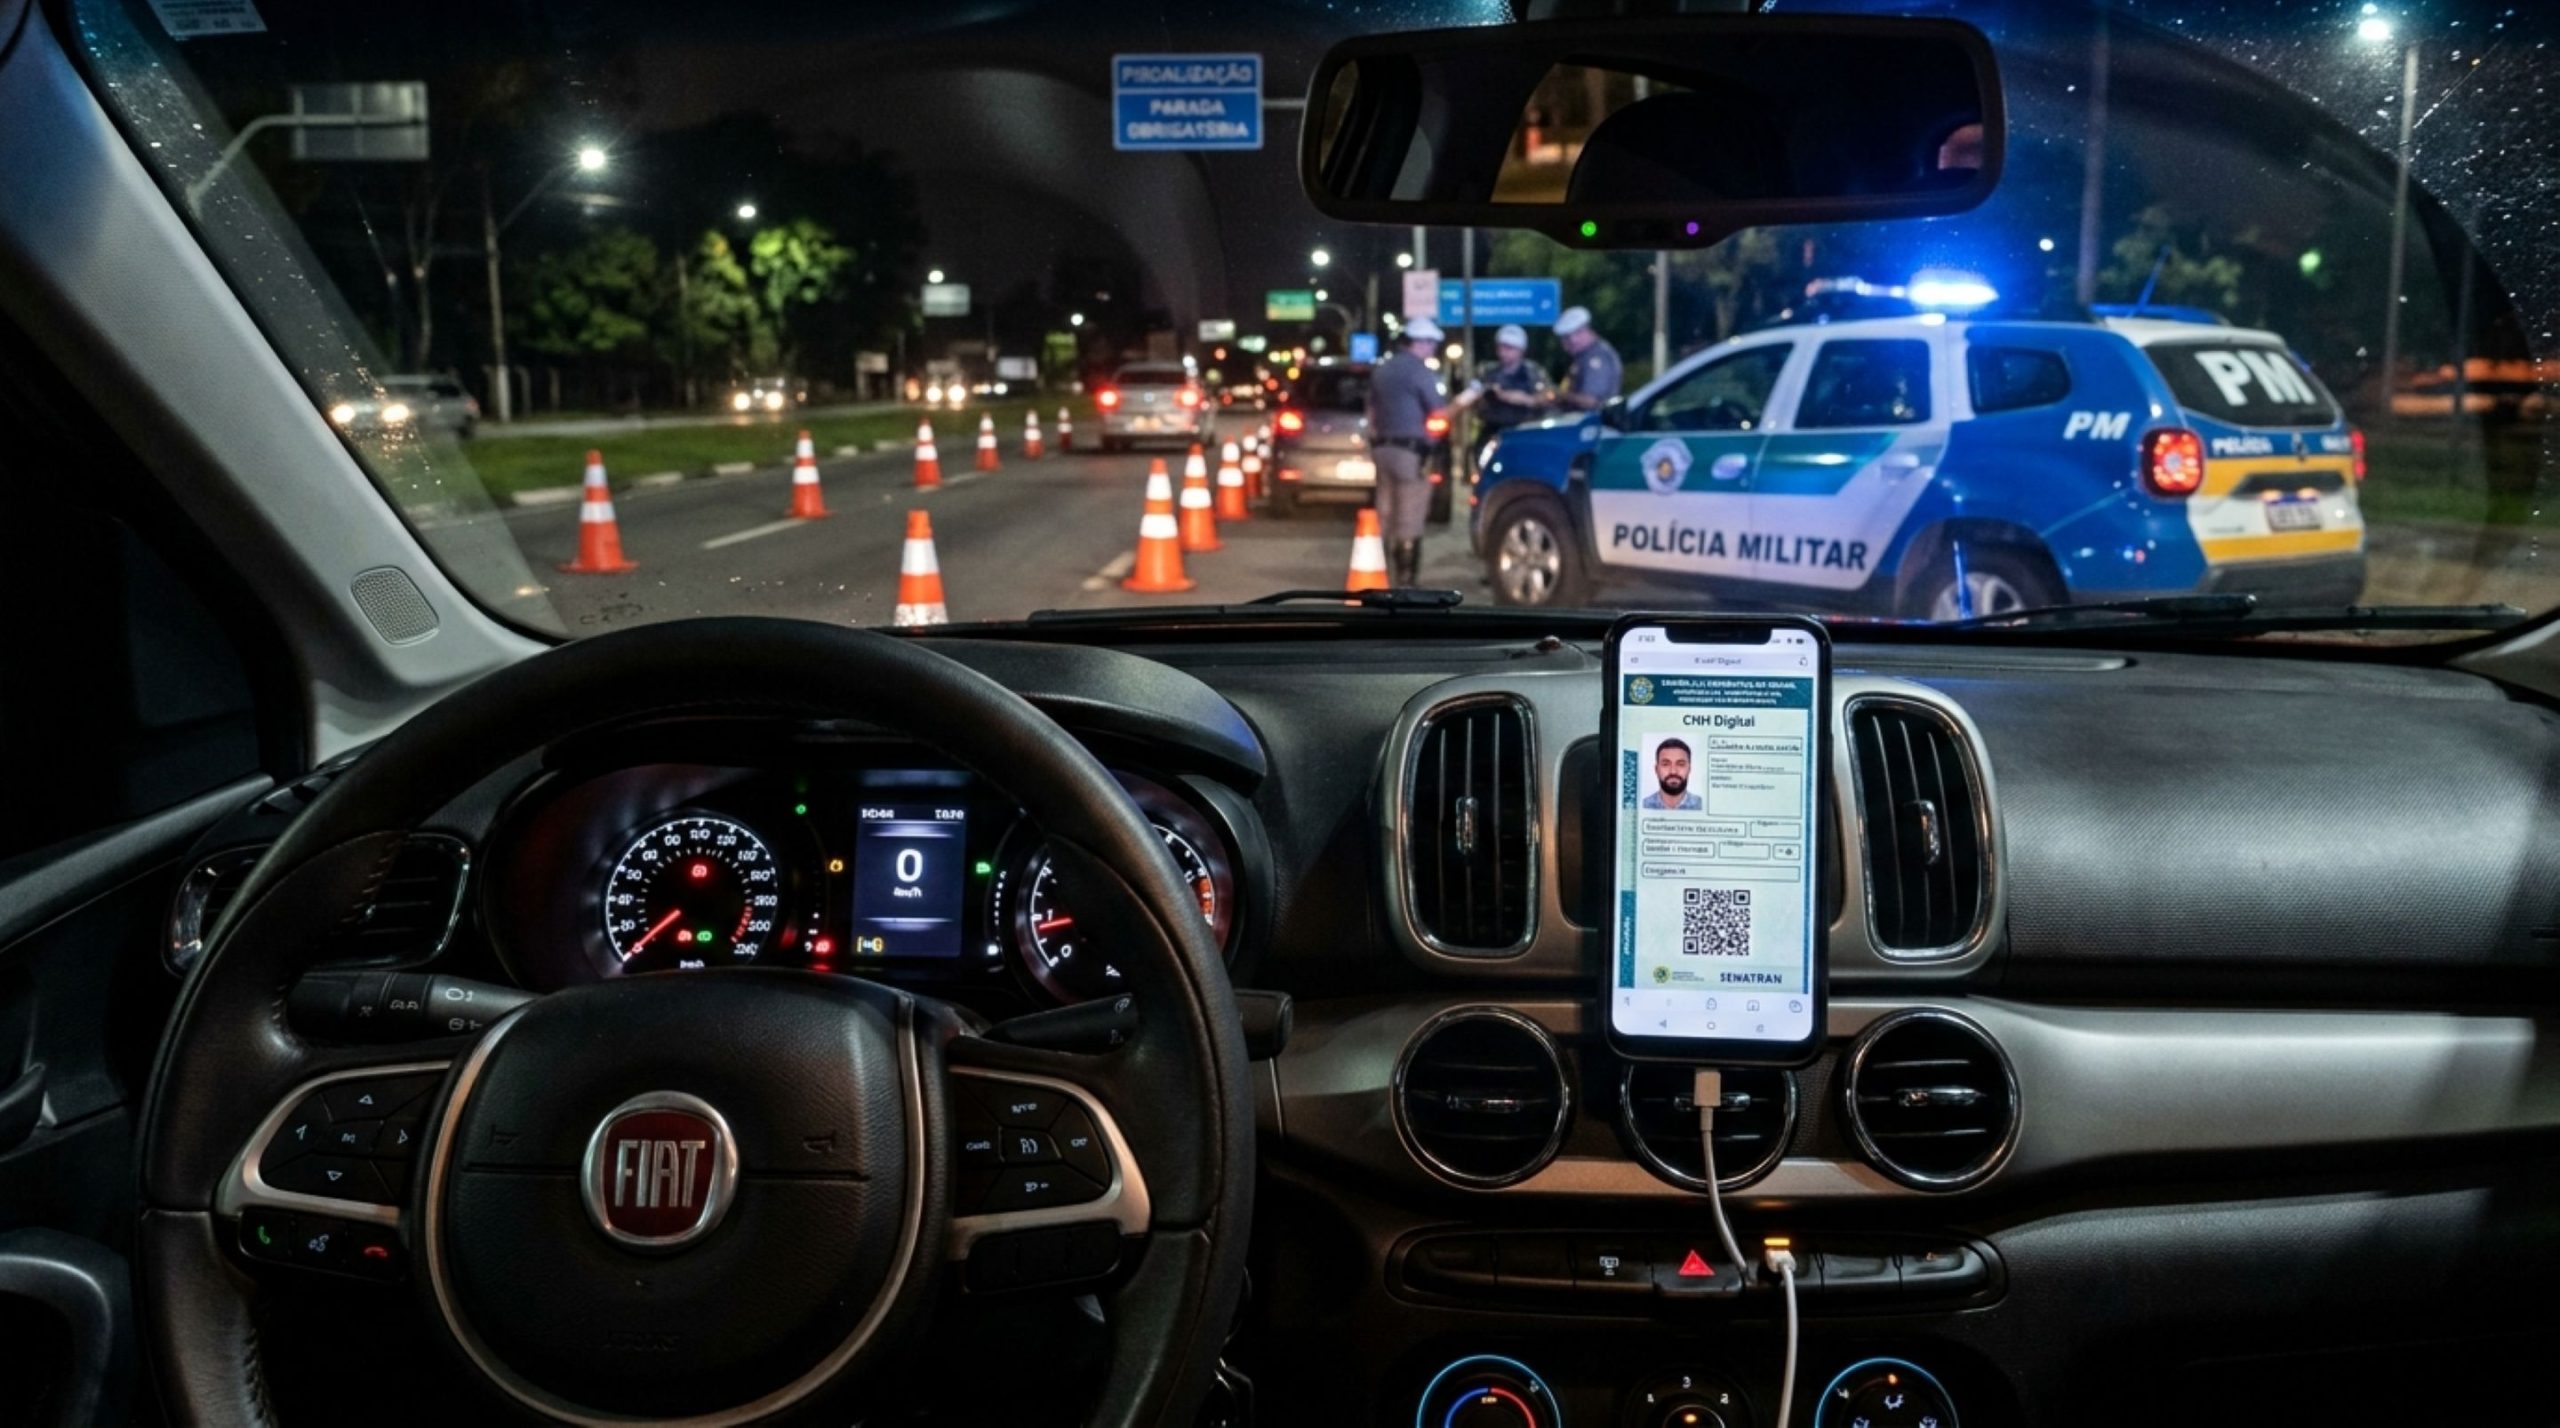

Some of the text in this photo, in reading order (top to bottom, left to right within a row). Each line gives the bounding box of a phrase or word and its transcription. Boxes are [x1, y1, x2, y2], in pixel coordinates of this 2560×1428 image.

[1150, 98, 1226, 116] PARADA
[2194, 350, 2317, 406] PM
[2063, 411, 2131, 440] PM
[1612, 518, 1869, 571] POLÍCIA MILITAR
[1682, 714, 1755, 729] CNH Digital
[896, 848, 923, 883] 0
[1061, 943, 1072, 958] 0
[614, 1139, 706, 1208] FIAT
